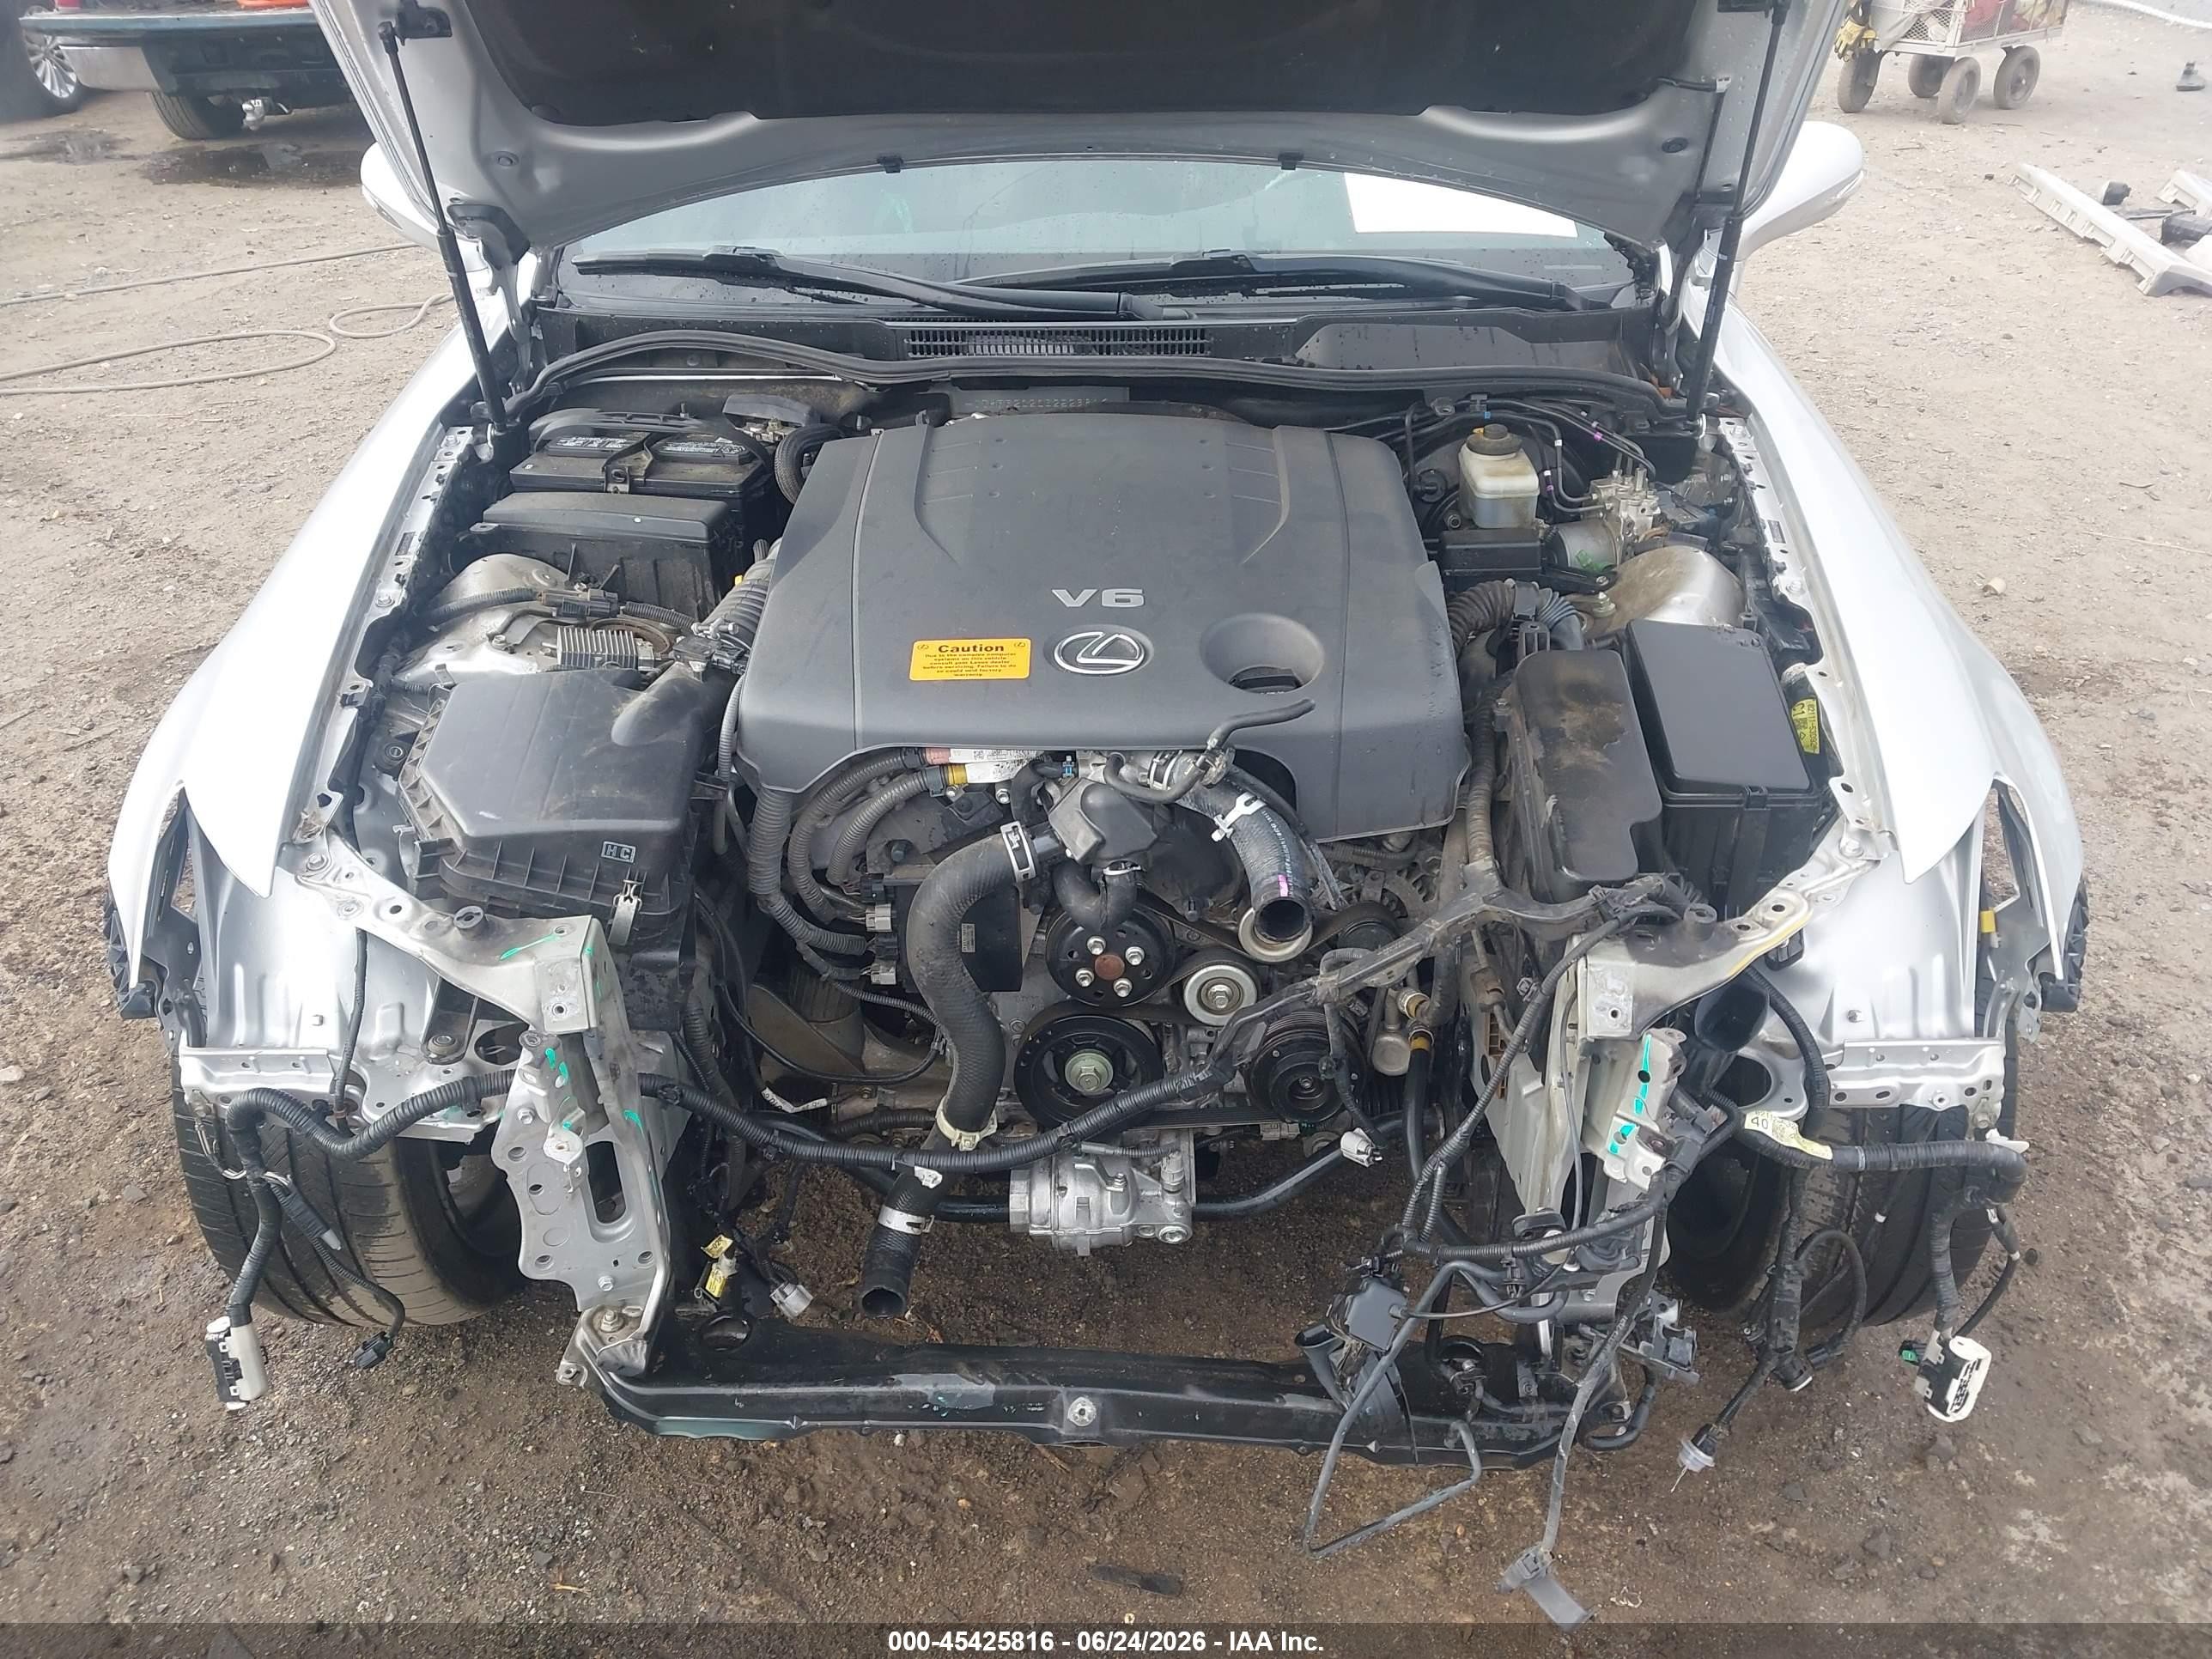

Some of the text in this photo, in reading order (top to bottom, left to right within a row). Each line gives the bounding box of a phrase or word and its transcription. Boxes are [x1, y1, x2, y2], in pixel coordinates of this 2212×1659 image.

[1052, 588, 1144, 607] V6
[938, 644, 1005, 653] Caution
[1751, 1116, 1769, 1130] 40
